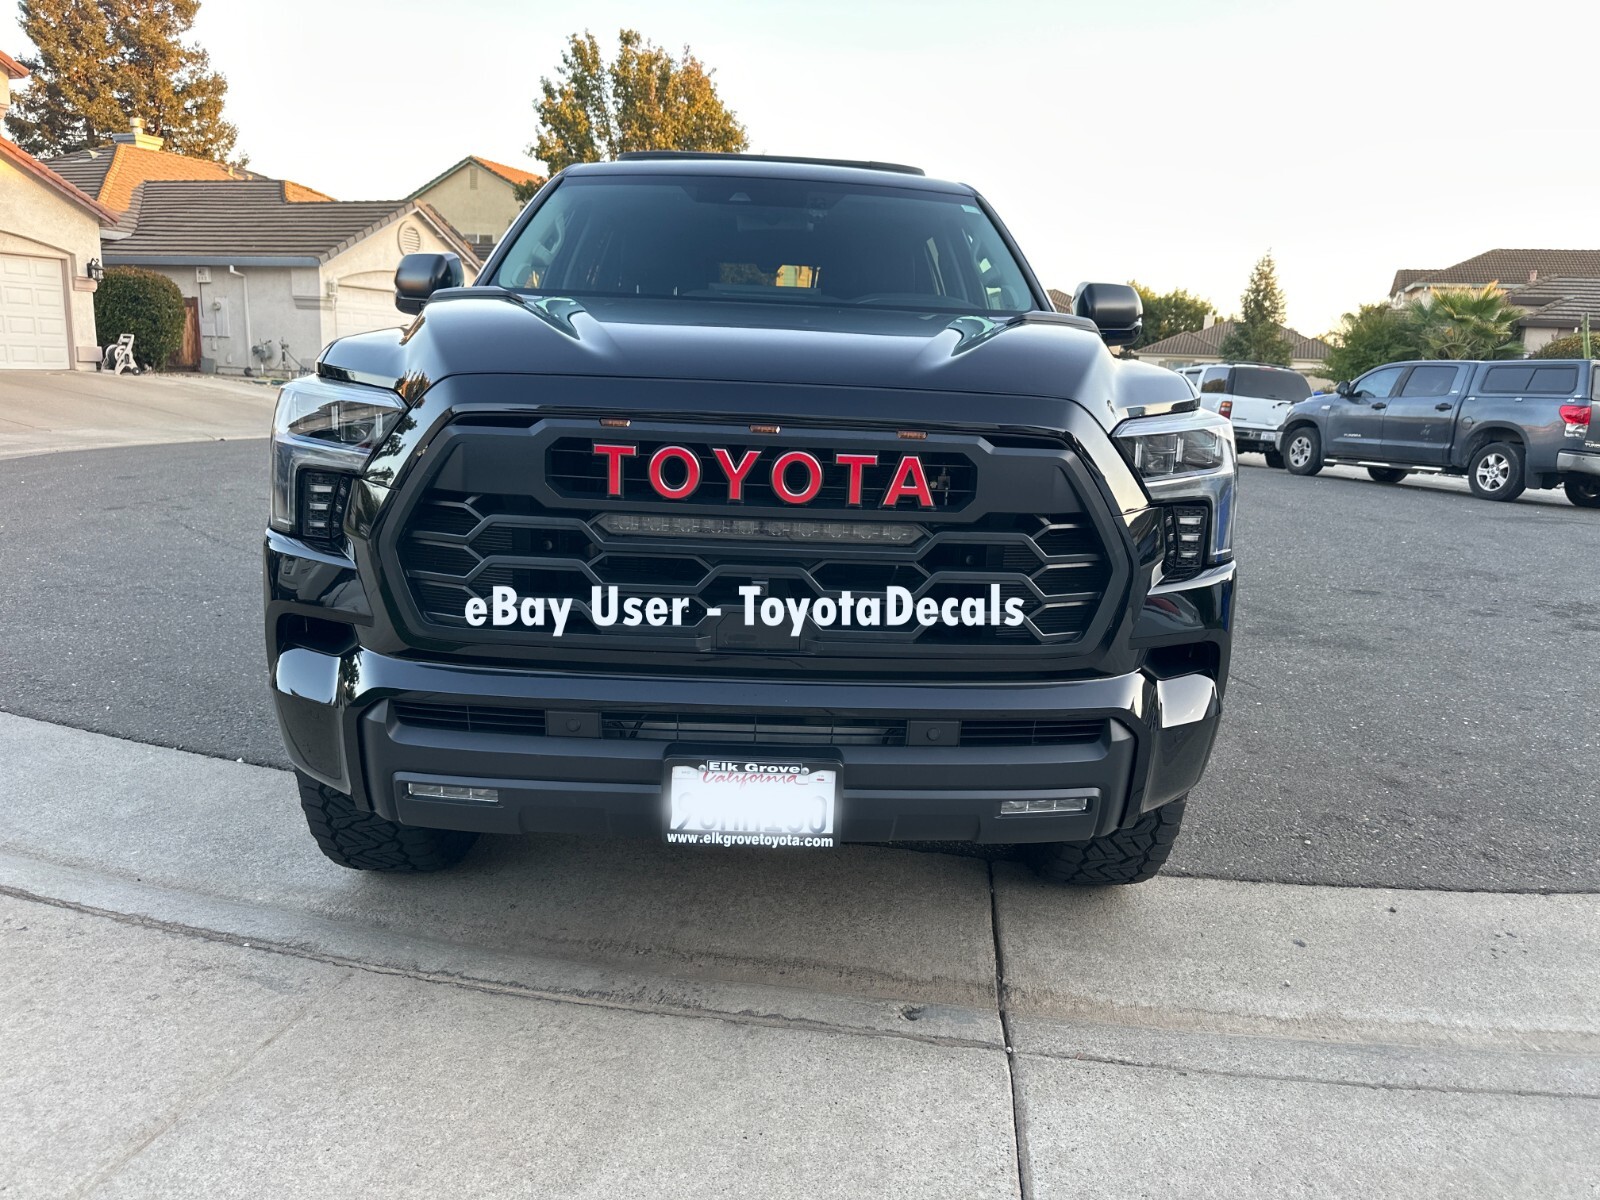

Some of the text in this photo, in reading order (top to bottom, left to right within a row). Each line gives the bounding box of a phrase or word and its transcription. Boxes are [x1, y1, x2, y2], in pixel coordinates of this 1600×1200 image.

[593, 444, 934, 508] TOYOTA
[709, 762, 800, 773] Elk Grove
[702, 772, 809, 788] California
[666, 832, 834, 848] www.elkgrovetoyota.com
